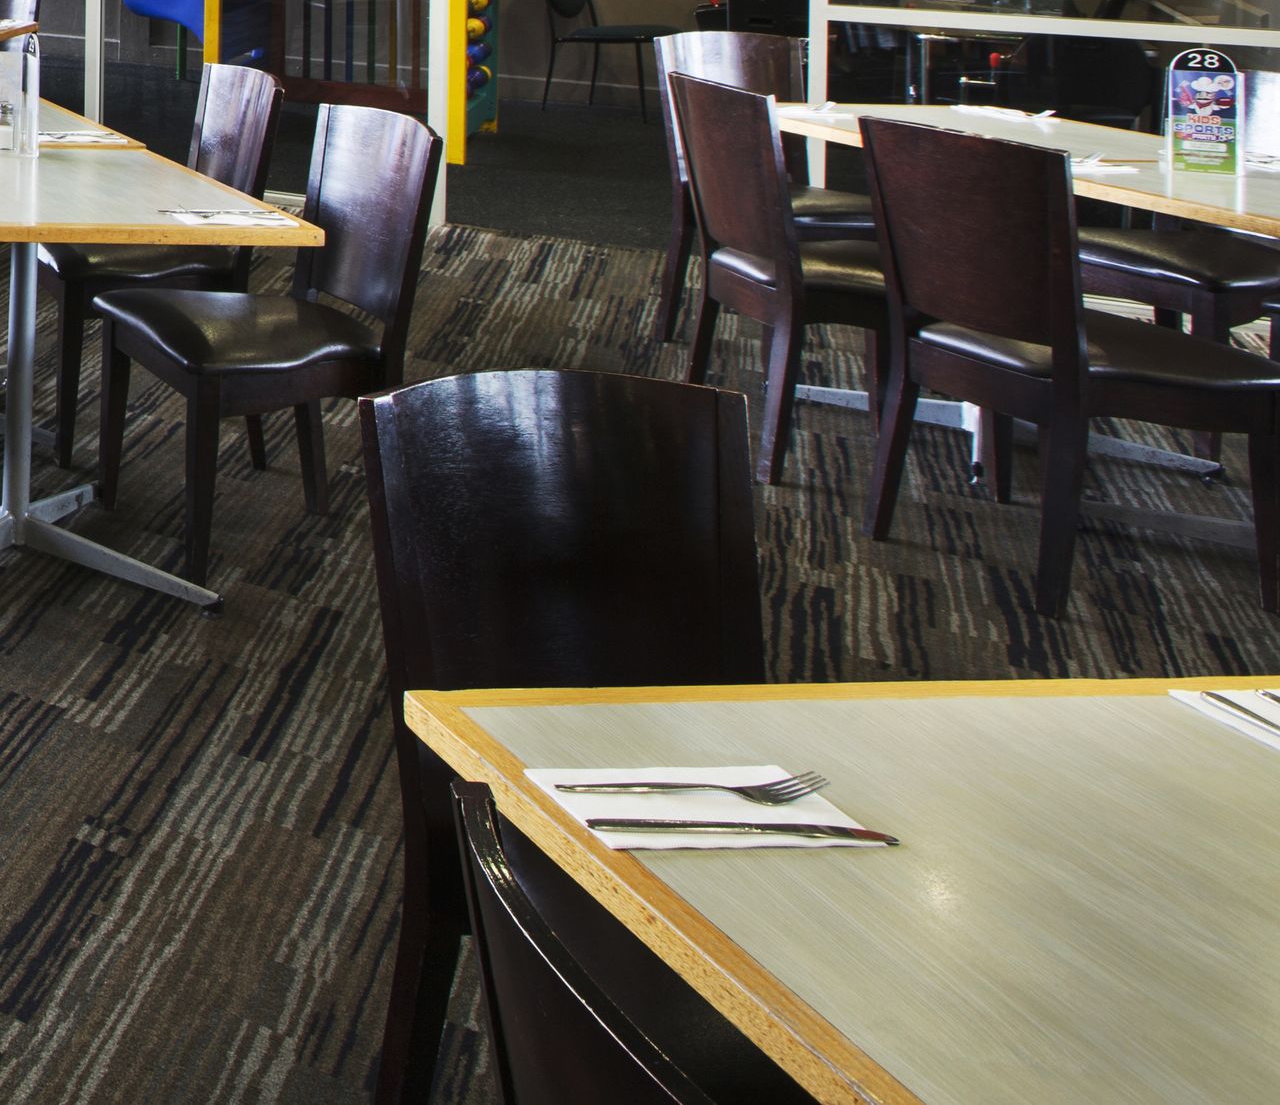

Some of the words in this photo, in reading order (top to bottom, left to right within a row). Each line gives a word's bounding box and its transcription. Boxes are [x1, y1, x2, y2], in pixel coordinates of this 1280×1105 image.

[1188, 53, 1220, 68] 28
[1188, 115, 1221, 125] KIDS
[1174, 123, 1234, 135] SPORTS
